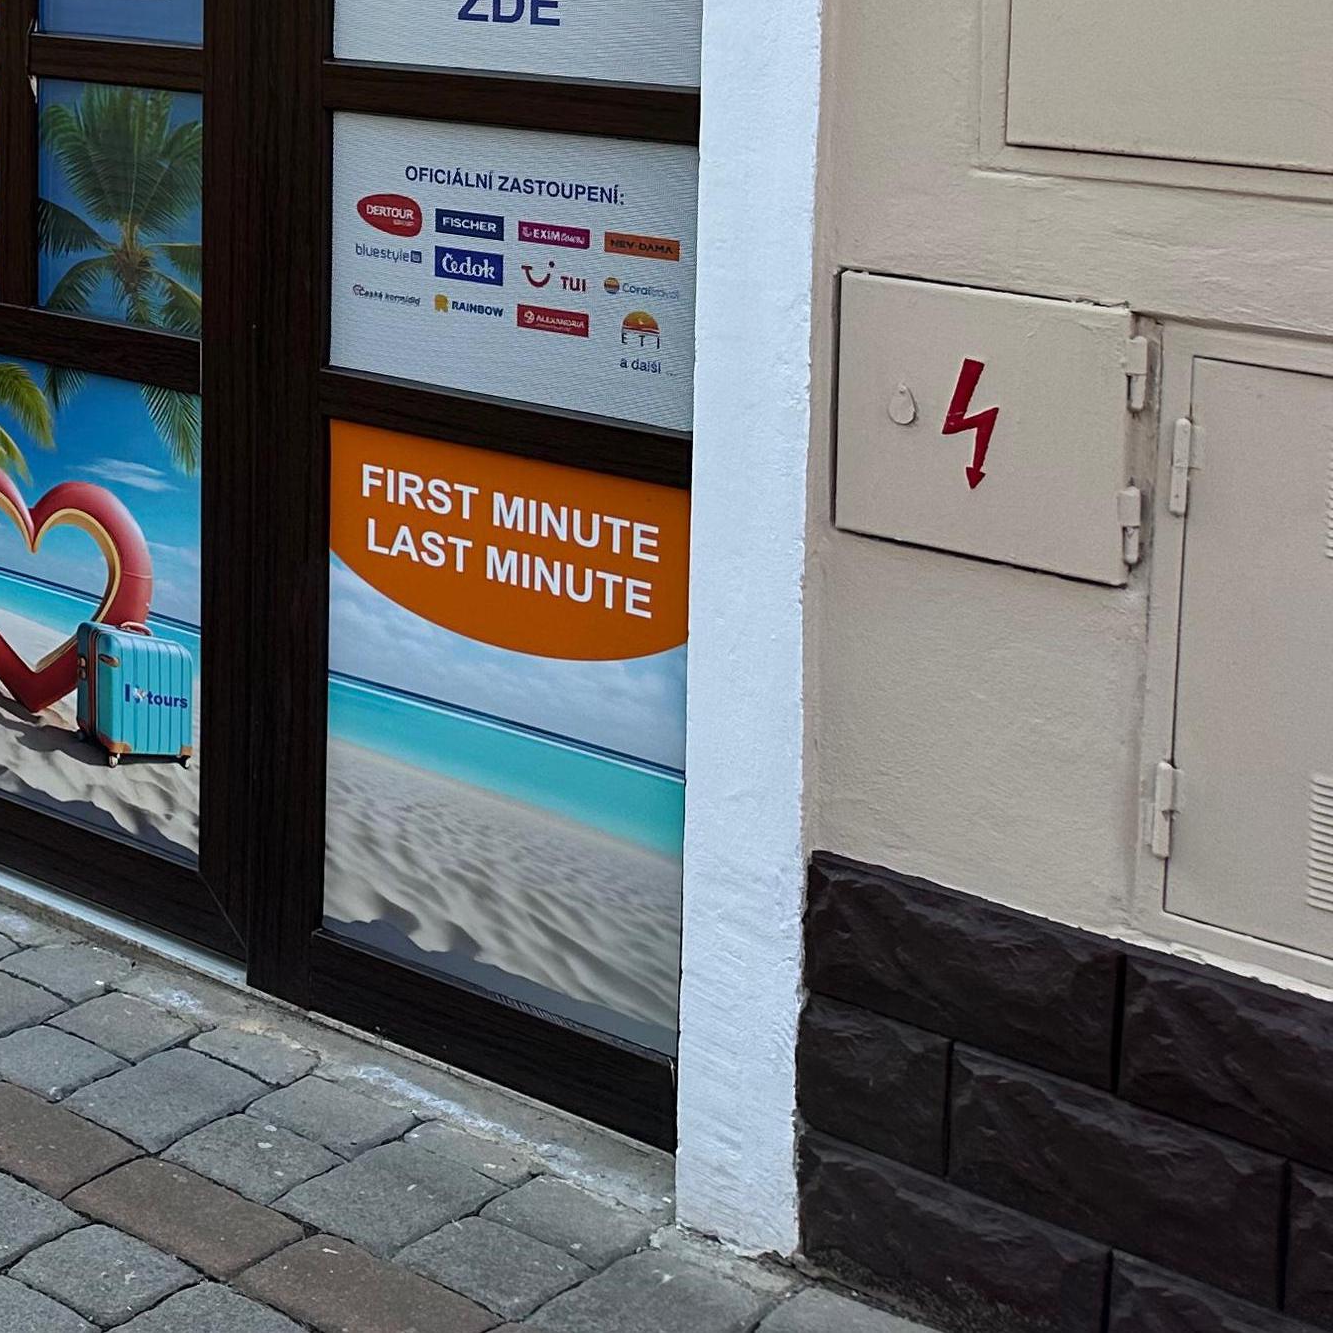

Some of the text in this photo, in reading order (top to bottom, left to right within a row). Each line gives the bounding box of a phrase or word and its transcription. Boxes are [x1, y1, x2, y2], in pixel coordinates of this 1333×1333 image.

[405, 165, 625, 206] OFICIÁLNÍ ZASTOUPENÍ:
[366, 204, 415, 220] DERTOUR
[442, 216, 497, 233] FISCHER
[442, 252, 496, 280] Čedok
[560, 275, 587, 292] TUI
[452, 301, 504, 317] RAINBOW
[361, 463, 660, 563] FIRST MINUTE
[367, 517, 653, 619] LAST MINUTE
[147, 691, 188, 709] tours
